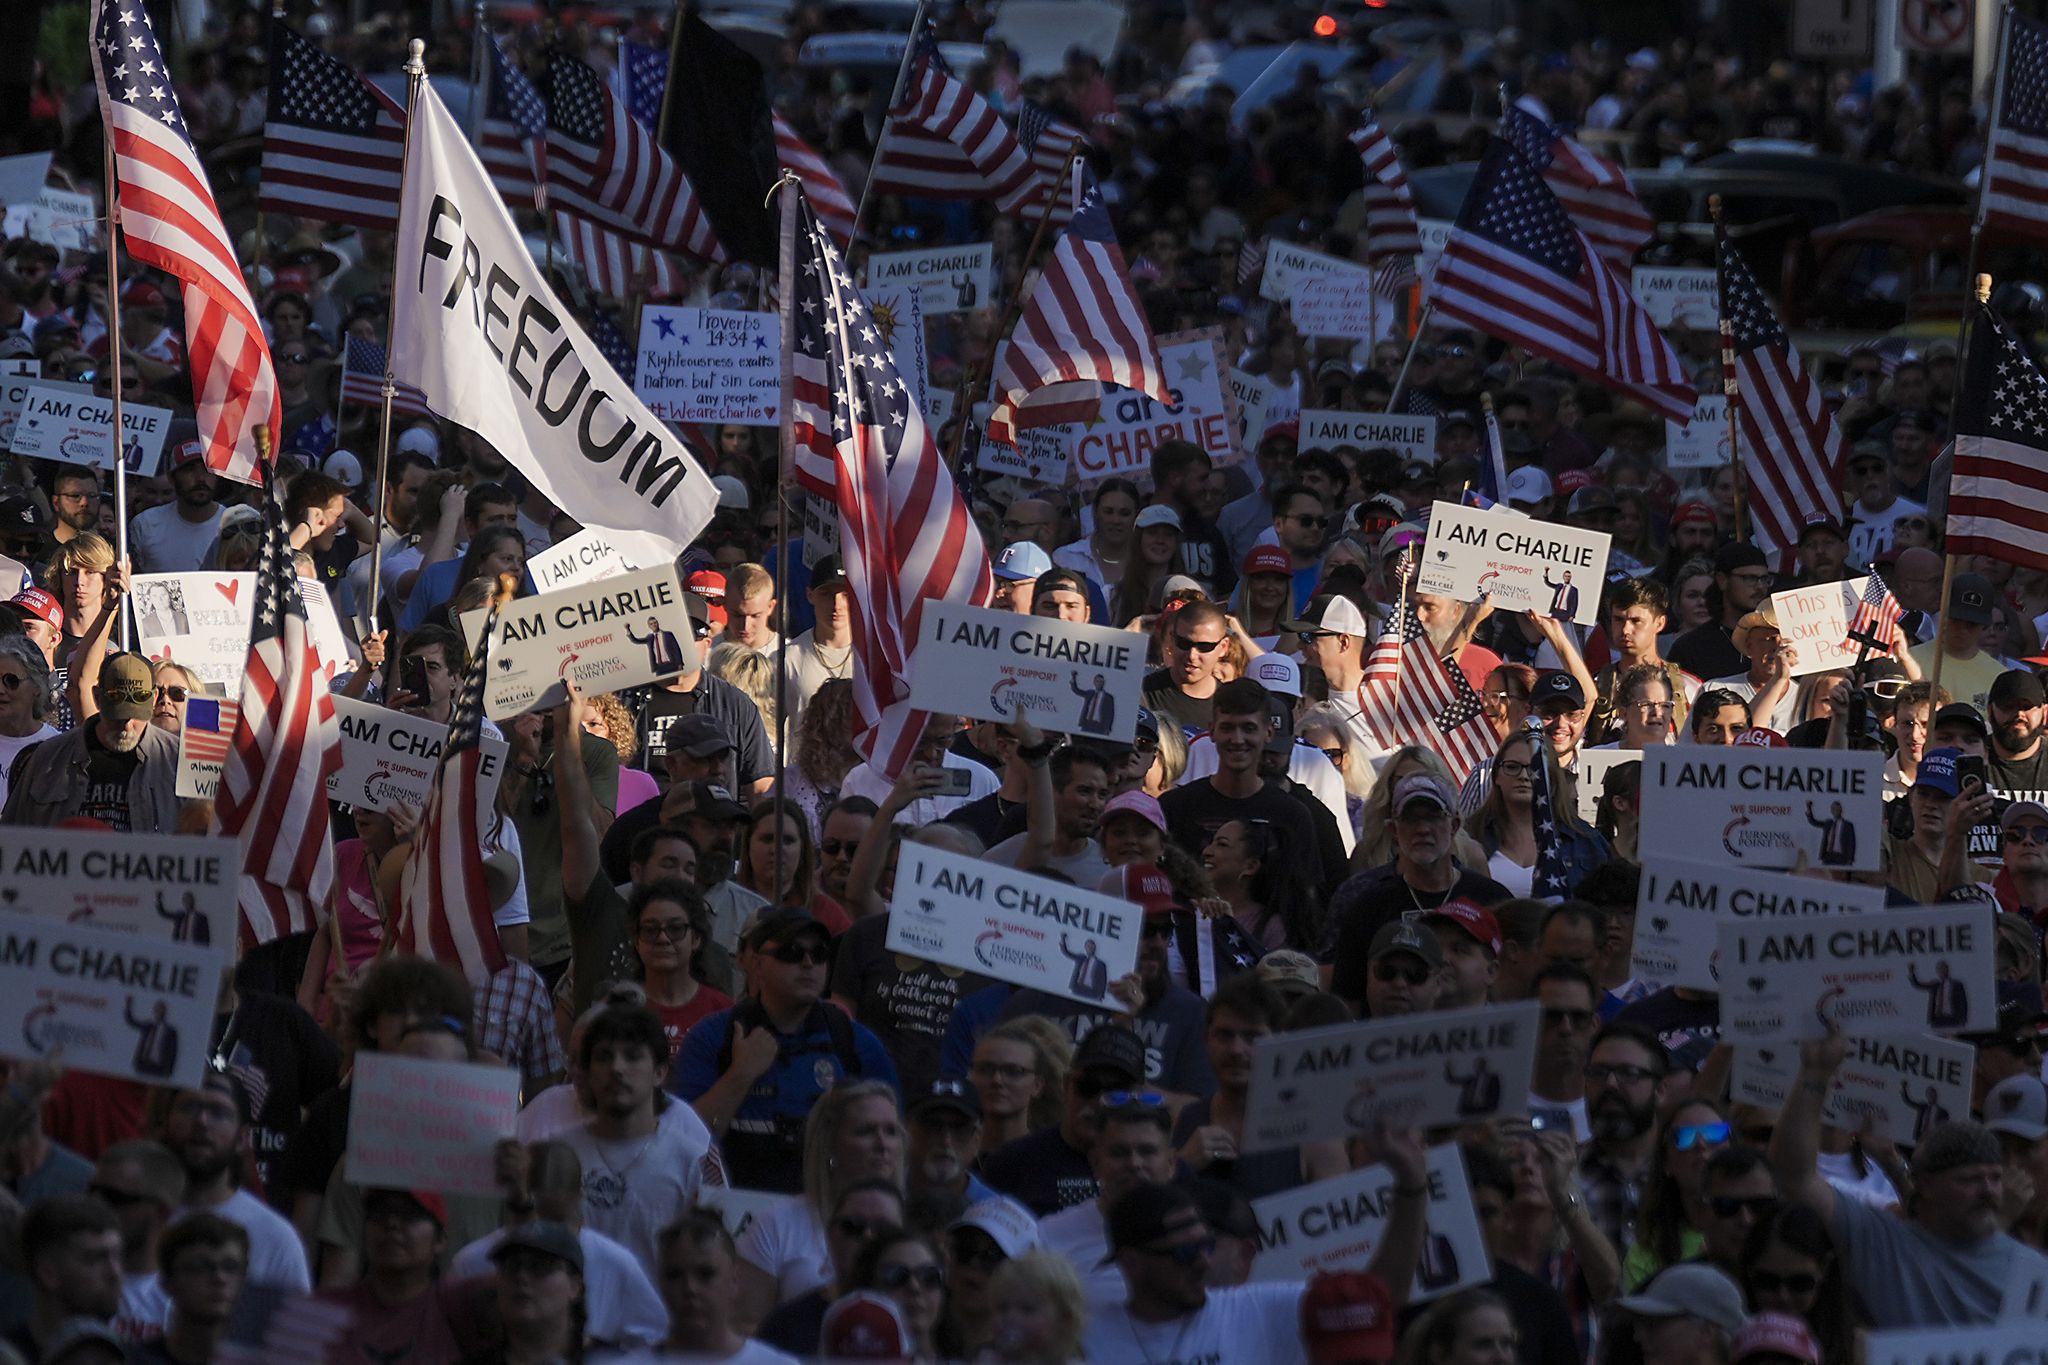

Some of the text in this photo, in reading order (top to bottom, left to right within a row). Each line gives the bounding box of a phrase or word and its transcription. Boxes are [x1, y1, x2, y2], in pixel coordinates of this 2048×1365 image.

[877, 254, 983, 278] I AM CHARLIE
[1282, 253, 1305, 270] AM
[1640, 278, 1644, 289] I
[1649, 278, 1673, 290] AM
[698, 309, 760, 330] Proverbs
[706, 330, 748, 347] 14:34
[739, 355, 774, 367] exalts
[692, 371, 716, 389] but
[696, 393, 759, 407] any people
[1230, 380, 1263, 406] RLIE
[28, 397, 158, 433] I AM CHARLIE
[1115, 388, 1184, 424] are
[1310, 422, 1425, 444] I AM CHARLIE
[1435, 520, 1594, 568] I AM CHARLIE
[1000, 547, 1015, 565] T
[541, 569, 550, 587] I
[554, 555, 578, 583] AM
[1486, 561, 1533, 576] WE SUPPORT
[1421, 579, 1454, 590] ROLL CALL
[1490, 581, 1529, 595] TURNING
[502, 582, 673, 645] AM CHARLIE
[1776, 592, 1826, 619] This
[1792, 619, 1822, 642] our
[557, 634, 614, 654] WE SUPPORT
[936, 618, 1130, 670] I AM CHARLIE
[572, 657, 620, 674] TURNING
[574, 663, 627, 682] POINT USA
[1000, 665, 1058, 682] WE SUPPORT
[1005, 690, 1053, 705] TURNING
[339, 715, 381, 744] AM
[376, 759, 428, 780] WE SUPPORT
[1925, 756, 1957, 767] AMERIC
[1926, 766, 1953, 777] FIRST
[1588, 765, 1591, 784] I
[1659, 763, 1866, 794] I AM CHARLIE
[378, 782, 422, 801] TURNING
[1730, 804, 1792, 816] WE SUPPORT
[1738, 838, 1794, 849] POINT USA
[1739, 830, 1791, 841] TURNING
[15, 848, 68, 876] AM
[82, 851, 220, 885] CHARLIE
[914, 861, 923, 885] I
[931, 868, 984, 901] AM
[994, 884, 1123, 940] CHARLIE
[1648, 877, 1655, 903] I
[1665, 880, 1718, 911] AM
[984, 917, 1046, 940] WE SUPPORT
[1738, 924, 1973, 963] I AM CHARLIE
[50, 943, 199, 998] CHARLIE
[1822, 971, 1892, 985] WE SUPPORT
[1273, 1022, 1518, 1079] I AM CHARLIE
[1301, 1241, 1371, 1270] WE SUPPORT
